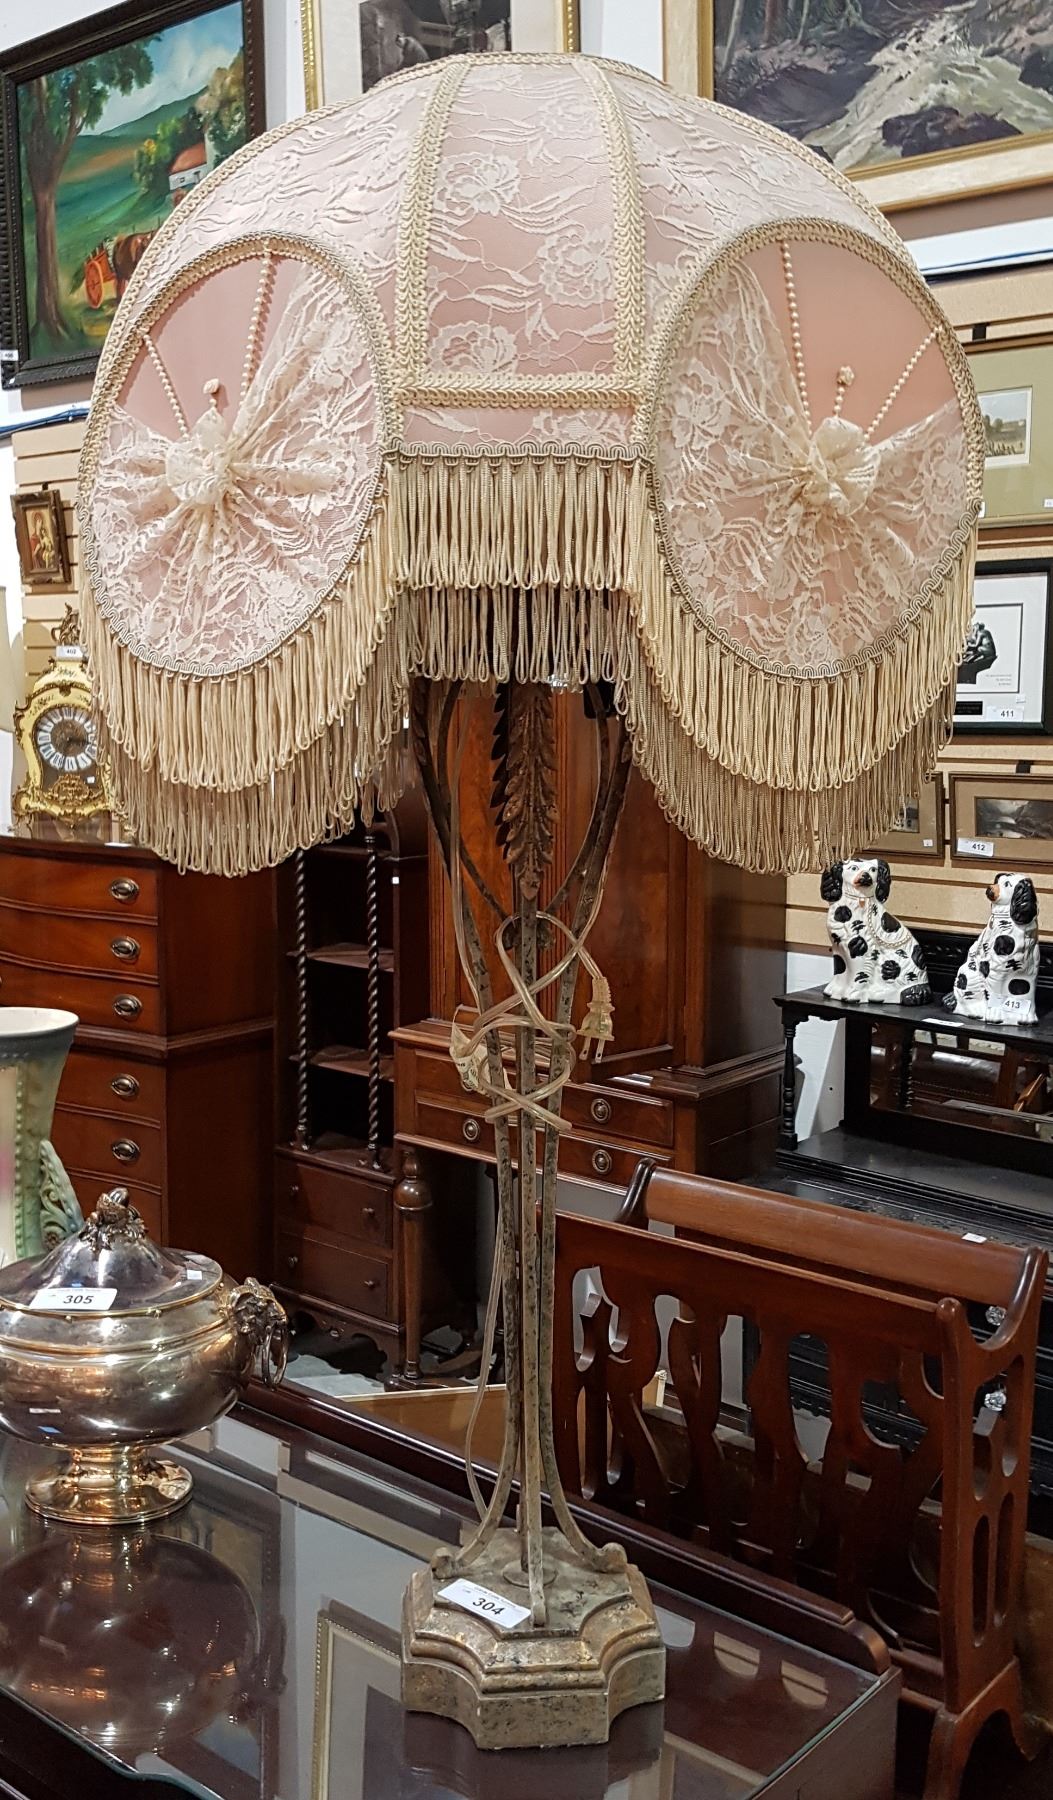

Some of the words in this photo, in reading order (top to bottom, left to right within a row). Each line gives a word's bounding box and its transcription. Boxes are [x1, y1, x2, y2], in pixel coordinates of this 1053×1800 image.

[972, 843, 986, 851] 412
[1005, 1000, 1020, 1009] 413
[63, 1295, 94, 1304] 305
[472, 1597, 505, 1616] 304
